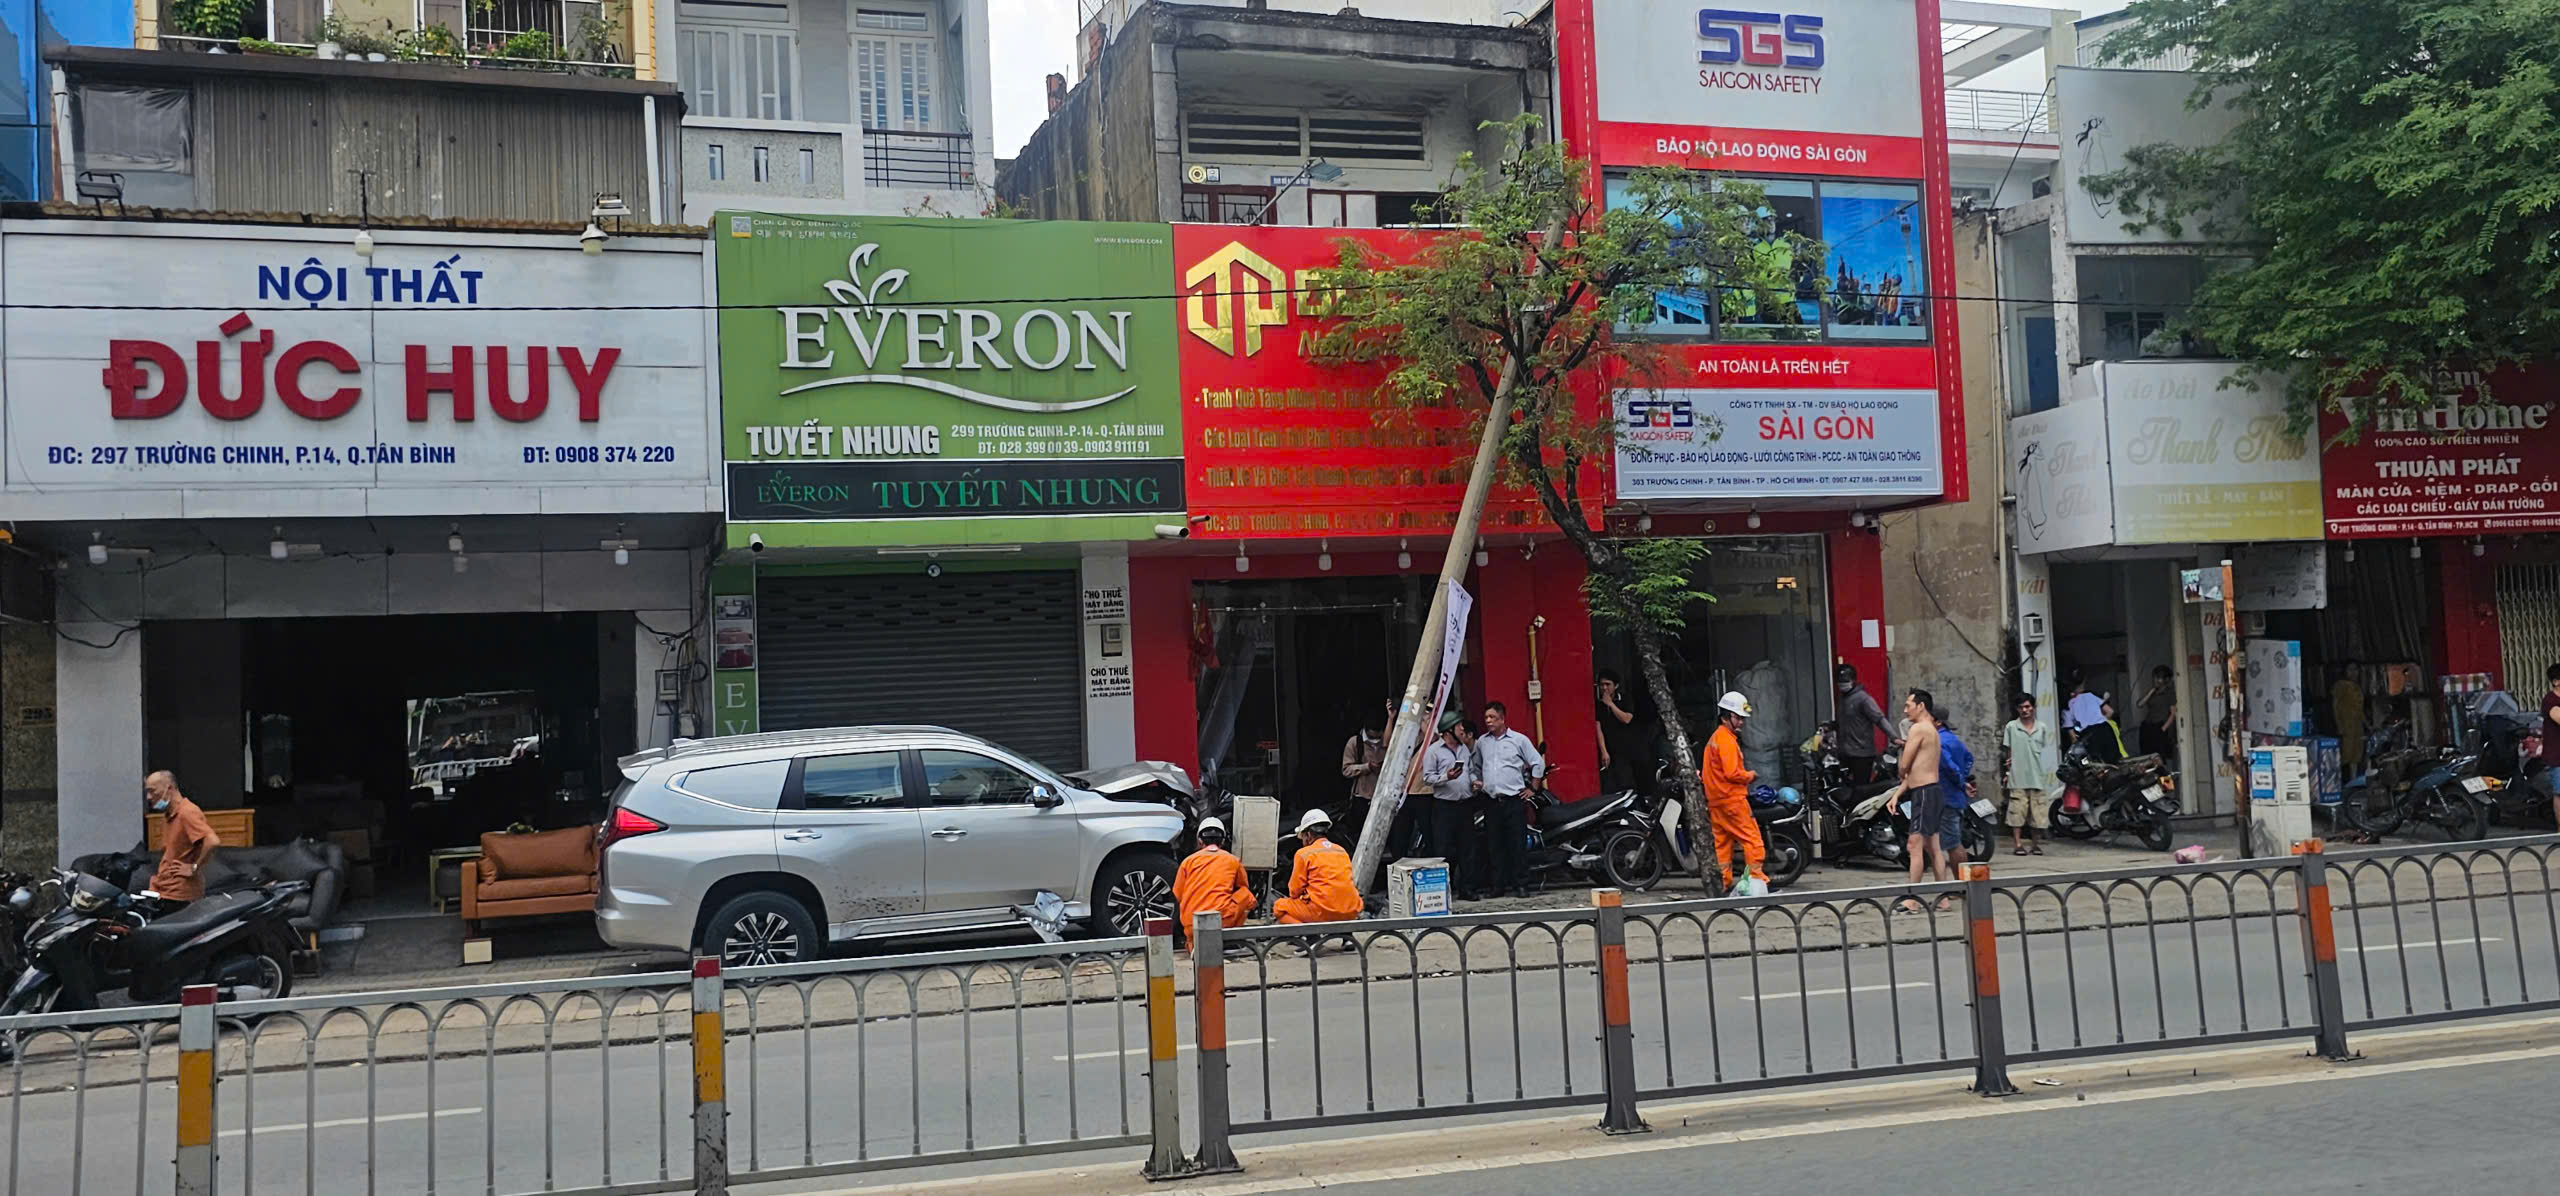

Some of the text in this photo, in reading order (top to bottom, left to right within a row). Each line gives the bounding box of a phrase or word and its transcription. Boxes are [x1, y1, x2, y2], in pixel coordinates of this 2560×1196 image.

[1699, 9, 1825, 69] SGS
[1700, 70, 1822, 94] SAIGON SAFETY
[1657, 136, 1691, 154] BẢO
[1722, 142, 1753, 157] LAO
[1757, 141, 1801, 161] ĐỘNG
[1806, 142, 1831, 161] SÀI
[1834, 145, 1867, 163] GÒN
[258, 254, 484, 310] NỘI THẤT
[777, 306, 1132, 371] EVERON
[103, 311, 621, 423] ĐỨC HUY
[1698, 360, 1718, 374] AN
[1721, 357, 1759, 374] TOÀN
[1762, 357, 1780, 374] LÀ
[1783, 358, 1819, 374] TRÊN
[1202, 388, 1232, 408] Tranh
[1729, 400, 1752, 409] CÔNG
[1754, 401, 1762, 409] TY
[1765, 401, 1784, 409] TNHH
[1787, 401, 1796, 409] SX
[1803, 401, 1813, 409] TM
[1819, 401, 1829, 409] DV
[1860, 401, 1876, 409] LAO
[1628, 401, 1693, 427] SGS
[1759, 410, 1874, 440] SÀI GÒN
[746, 418, 940, 457] TUYẾT NHUNG
[951, 425, 975, 437] 299
[977, 422, 1025, 437] TRƯỜNG
[1137, 422, 1165, 436] BÌNH
[1630, 432, 1663, 441] SAIGON
[2374, 438, 2403, 447] 100%
[2405, 437, 2427, 446] CAO
[2484, 432, 2519, 444] NHIÊN
[48, 438, 455, 467] ĐC: 297 TRƯỜNG CHINH, P.14, Q.TÂN BÌNH
[523, 446, 674, 464] ĐT: 0908 374 220
[978, 441, 996, 454] ĐT:
[1000, 441, 1022, 453] 028
[1654, 452, 1675, 466] PHỤC
[1711, 452, 1726, 462] LAO
[1774, 450, 1795, 462] CÔNG
[1822, 451, 1842, 461] PCCC
[1847, 451, 1857, 461] AN
[1859, 450, 1877, 461] TOÀN
[1879, 451, 1895, 461] GIAO
[1898, 449, 1921, 461] THÔNG
[2375, 453, 2521, 482] THUẬN PHÁT
[757, 483, 850, 503] EVERON
[872, 467, 1160, 509] TUYẾT NHUNG
[1680, 477, 1703, 486] CHINH
[2337, 475, 2558, 499] MÀN CỬA NỆM DRAP GỐI
[2357, 494, 2544, 516] CÁC LOẠI CHIẾU GIẤY DÁN TƯỜNG
[1091, 664, 1128, 676] CHO THUÊ
